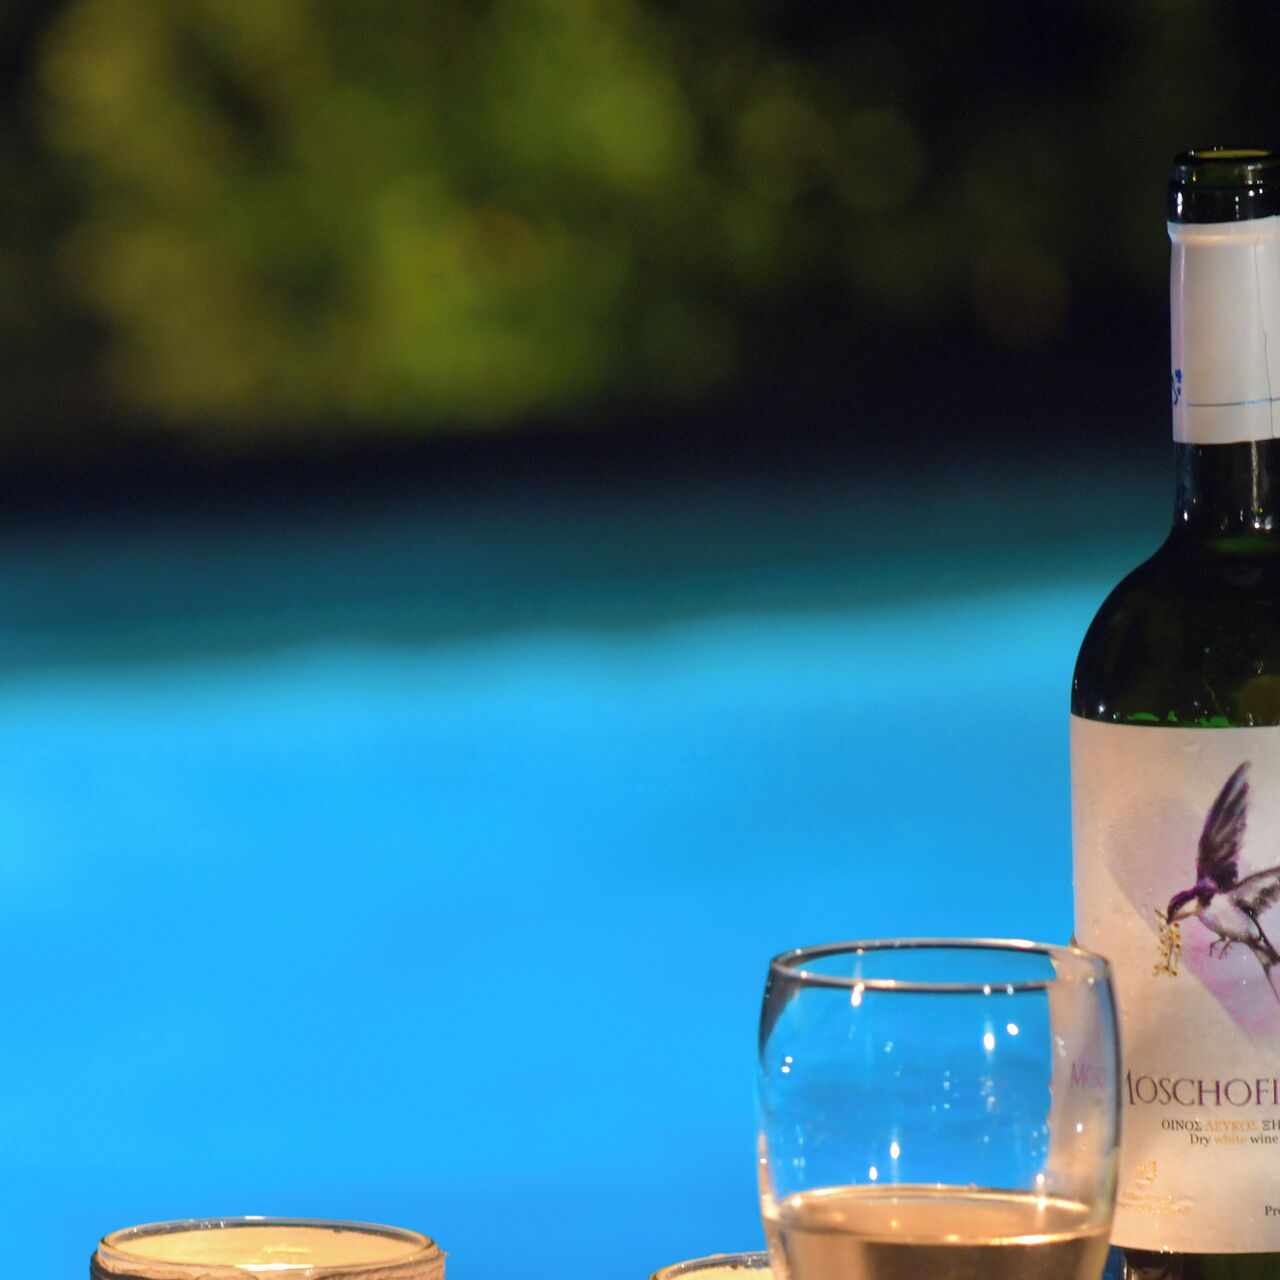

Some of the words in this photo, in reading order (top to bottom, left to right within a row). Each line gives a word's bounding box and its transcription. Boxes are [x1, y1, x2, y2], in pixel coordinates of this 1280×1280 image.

[1190, 1133, 1211, 1147] Dry
[1214, 1133, 1248, 1145] white
[1250, 1133, 1279, 1145] wine
